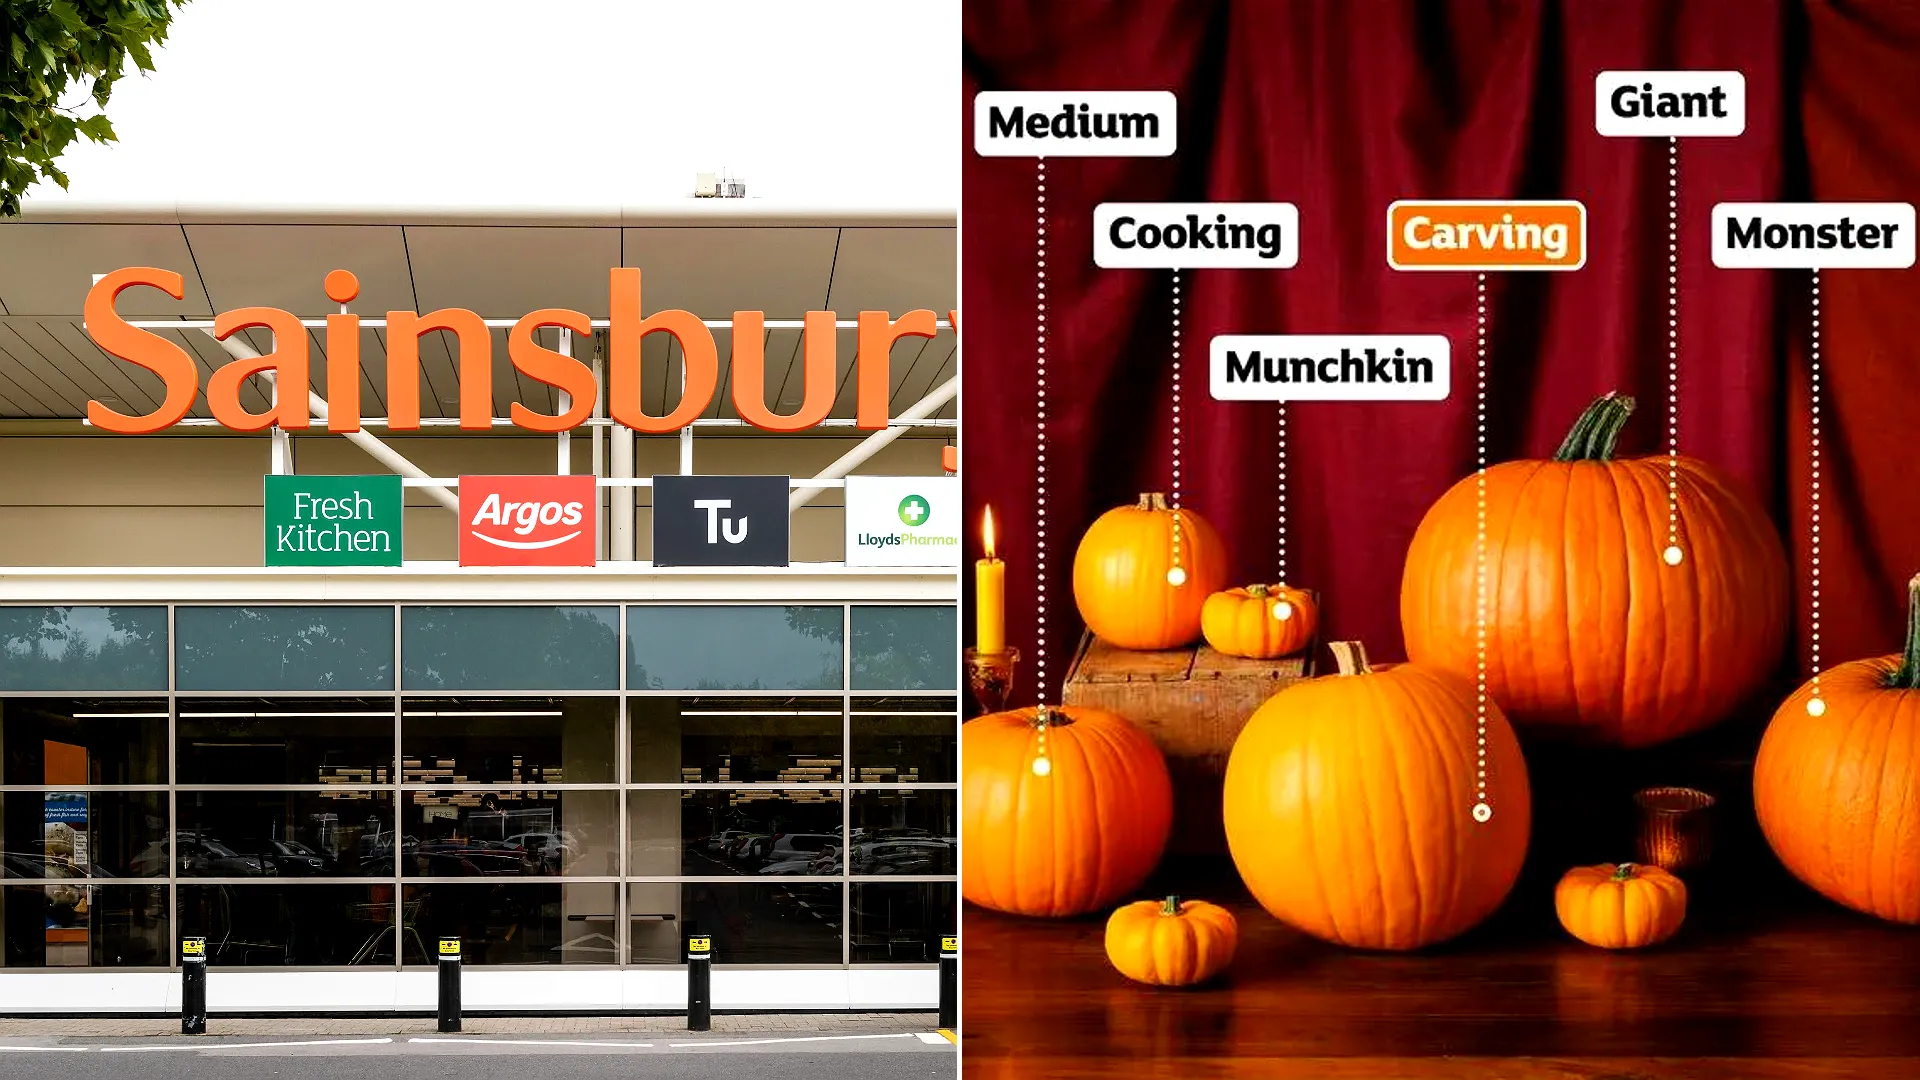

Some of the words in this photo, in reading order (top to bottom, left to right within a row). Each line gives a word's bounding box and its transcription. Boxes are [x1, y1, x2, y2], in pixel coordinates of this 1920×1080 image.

[84, 267, 957, 471] Sainsbur
[293, 491, 374, 520] Fresh
[471, 493, 584, 536] Argos
[694, 499, 748, 544] Tu
[276, 523, 391, 552] Kitchen
